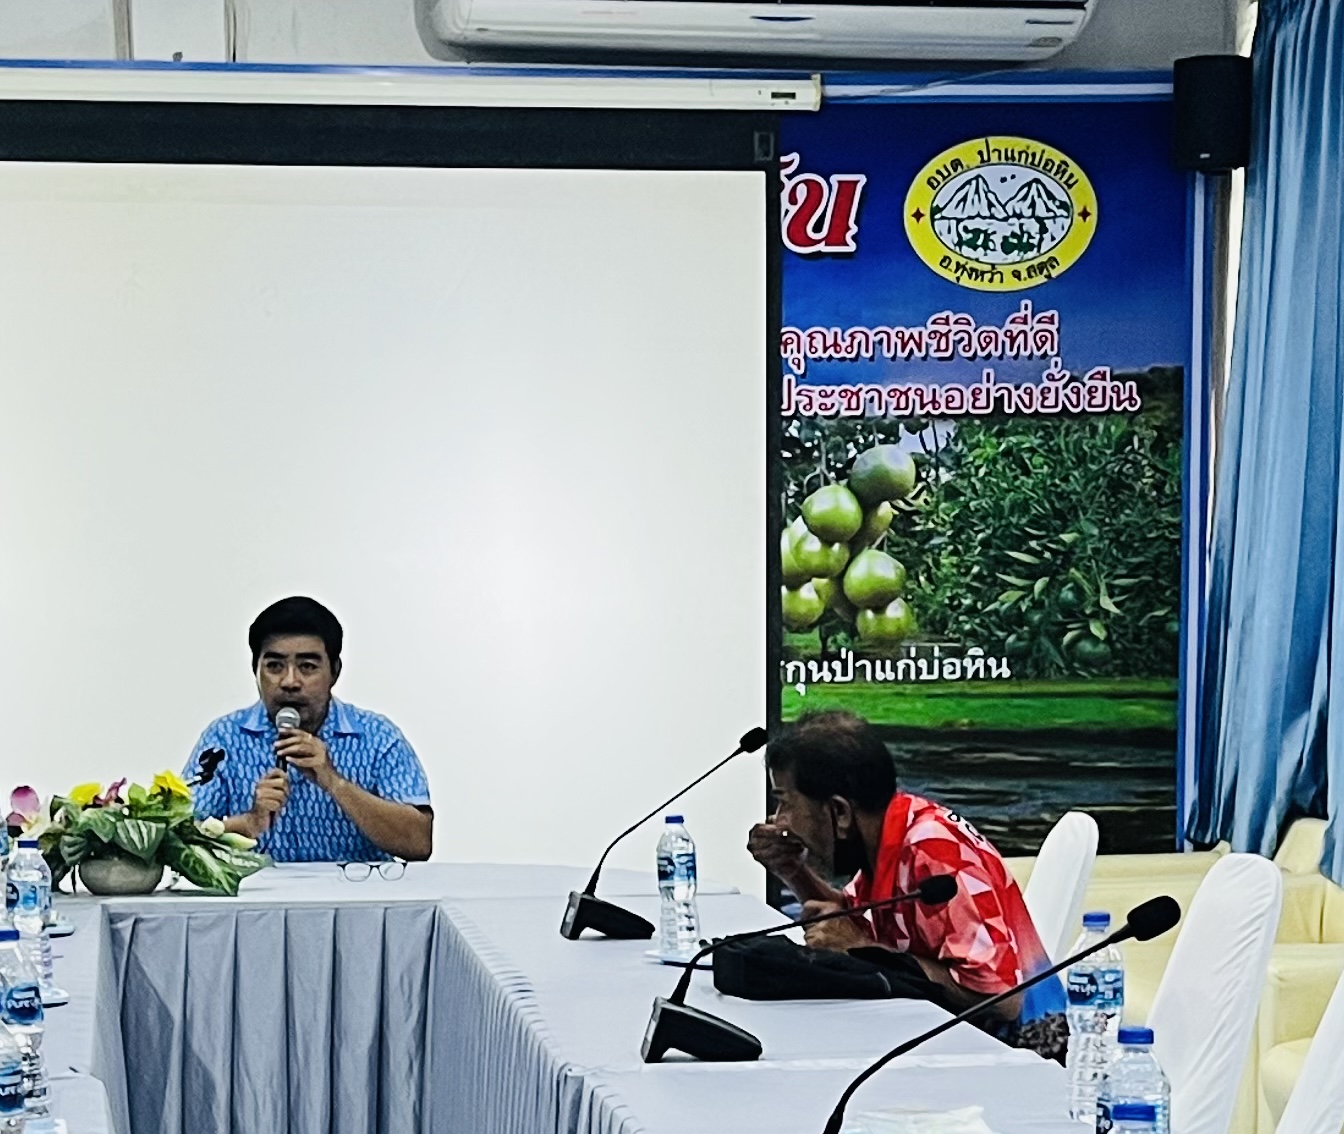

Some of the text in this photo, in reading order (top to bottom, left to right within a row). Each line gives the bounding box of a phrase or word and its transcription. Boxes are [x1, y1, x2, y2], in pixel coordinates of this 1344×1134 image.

[780, 301, 1059, 374] คุณภาพชีวิตที่ดี
[780, 647, 1012, 696] กุนป่าแก่บ่อหิน
